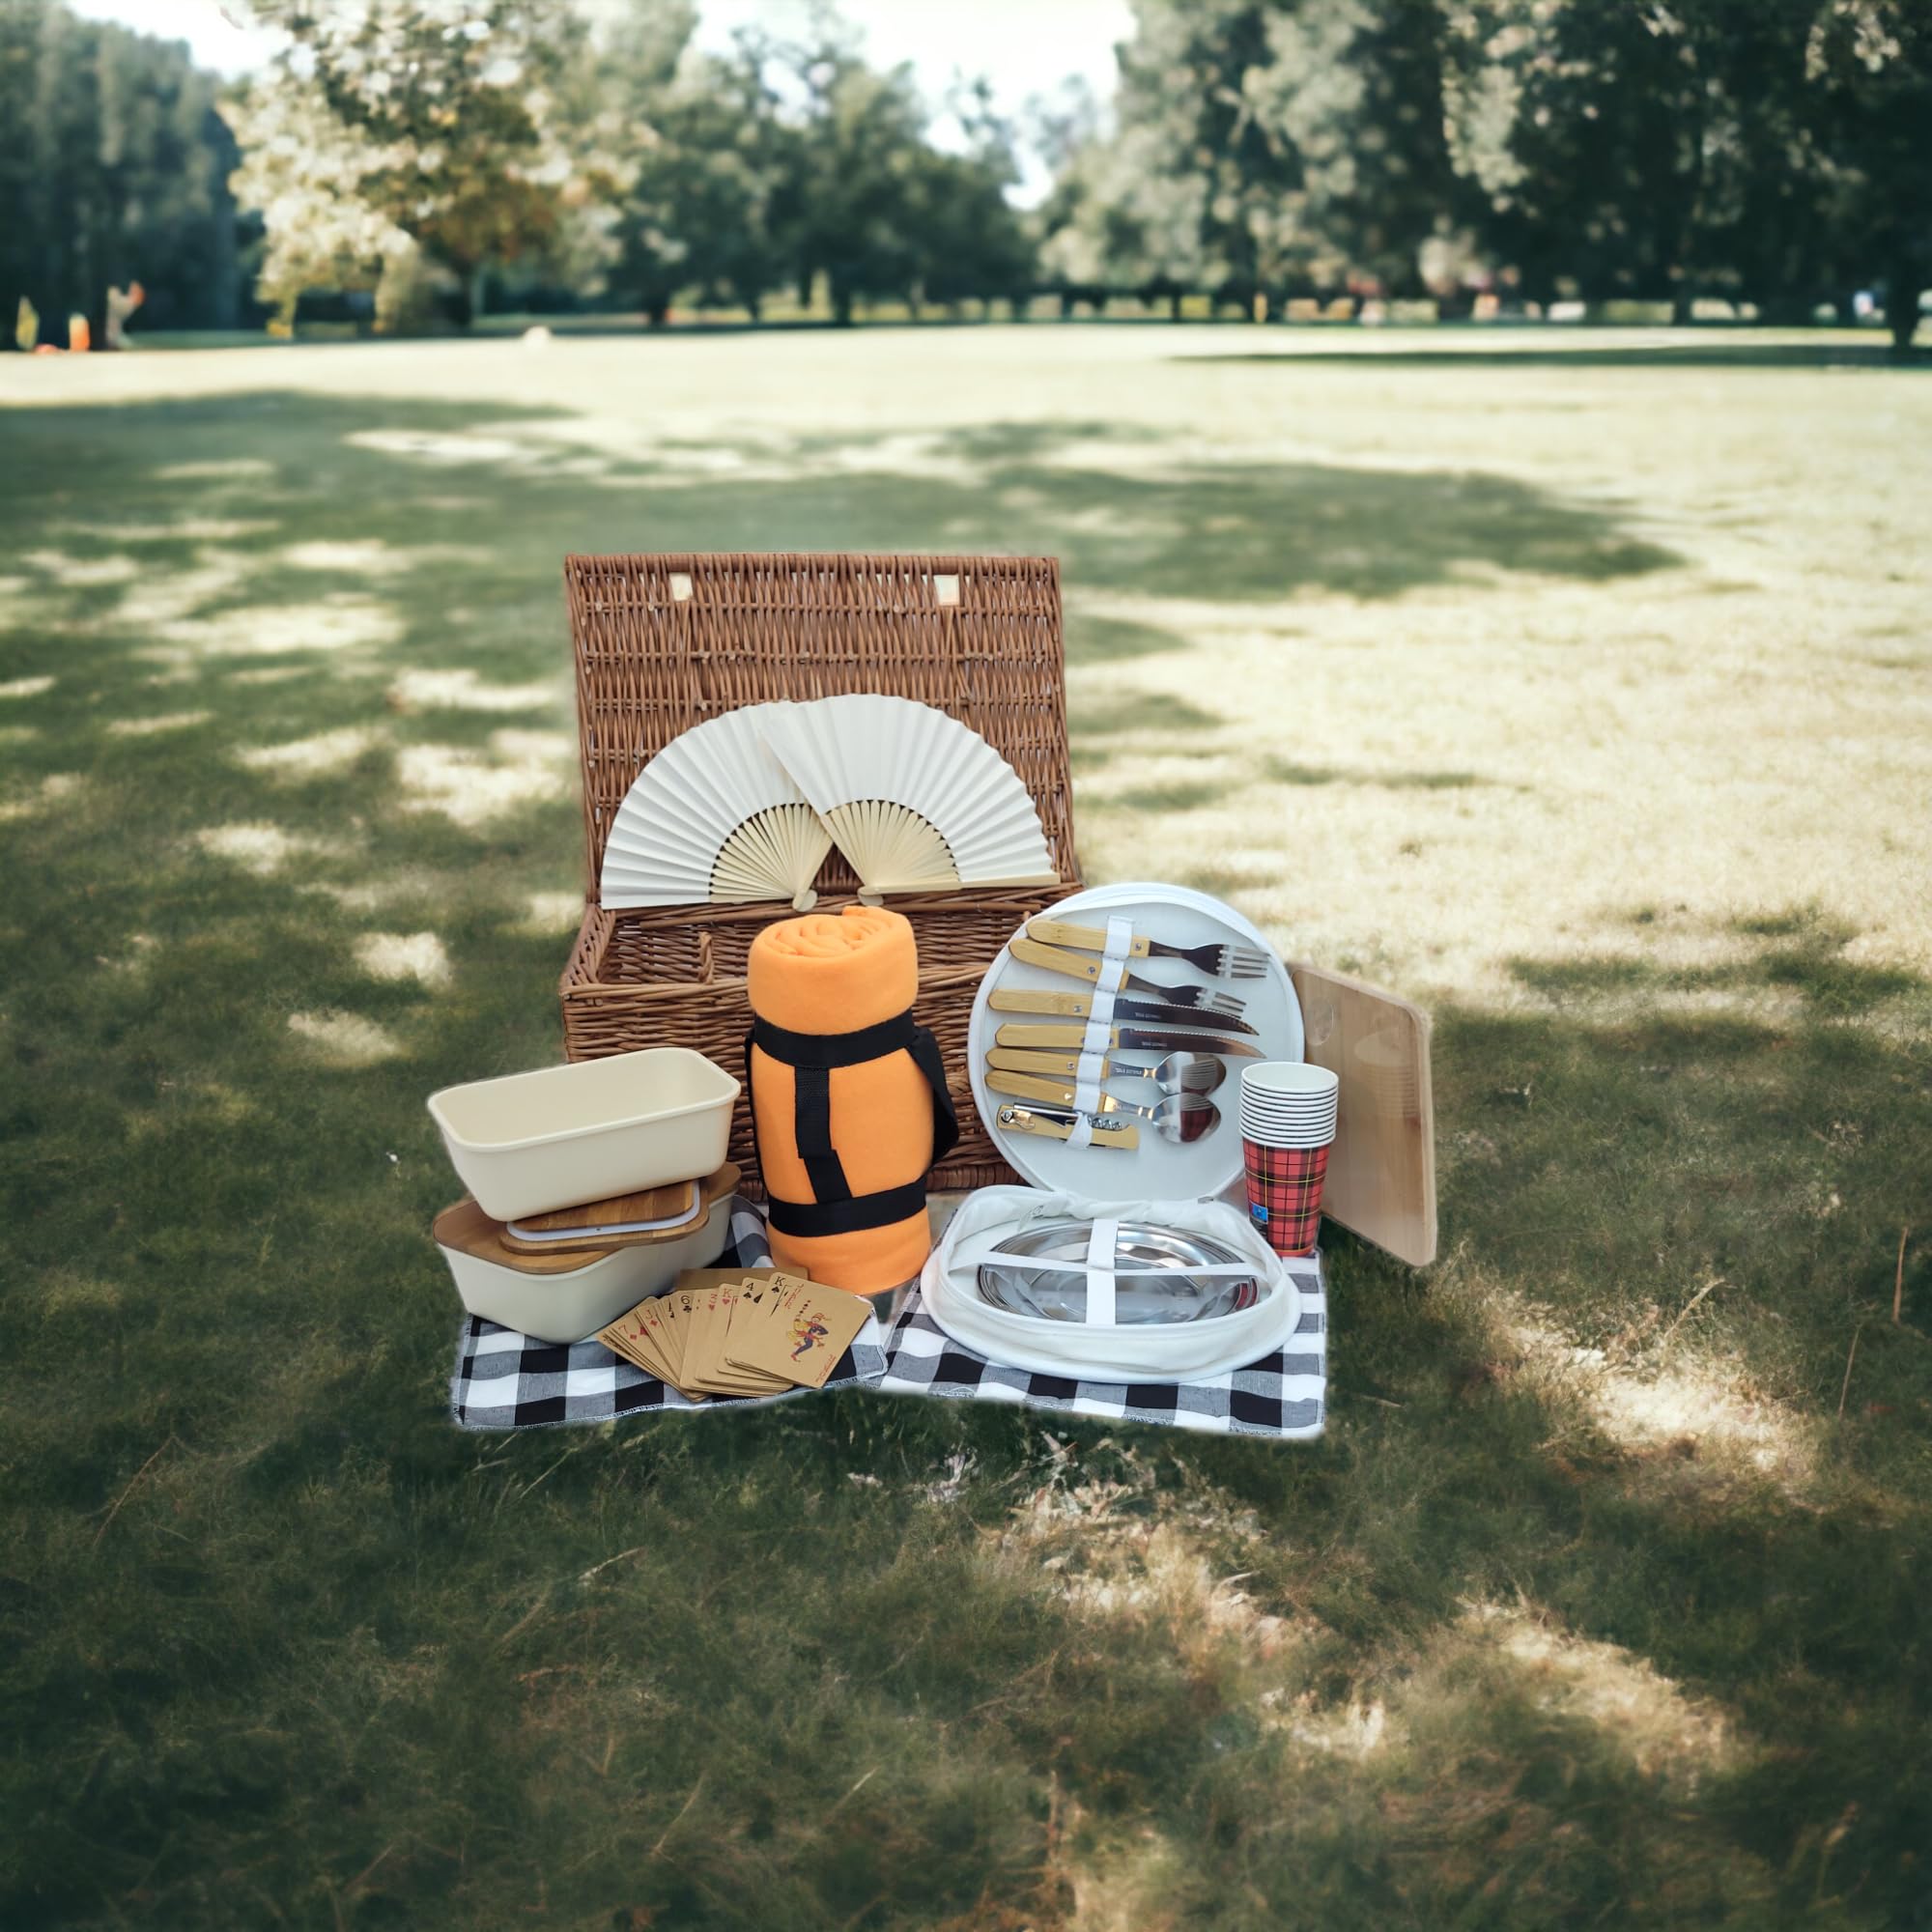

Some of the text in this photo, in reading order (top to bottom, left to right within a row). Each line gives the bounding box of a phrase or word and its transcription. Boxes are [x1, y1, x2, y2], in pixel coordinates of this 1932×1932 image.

[746, 1282, 754, 1292] 4
[775, 1276, 786, 1287] K
[724, 1288, 732, 1298] K
[680, 1294, 691, 1305] 6
[645, 1308, 653, 1320] J
[618, 1323, 628, 1334] 7
